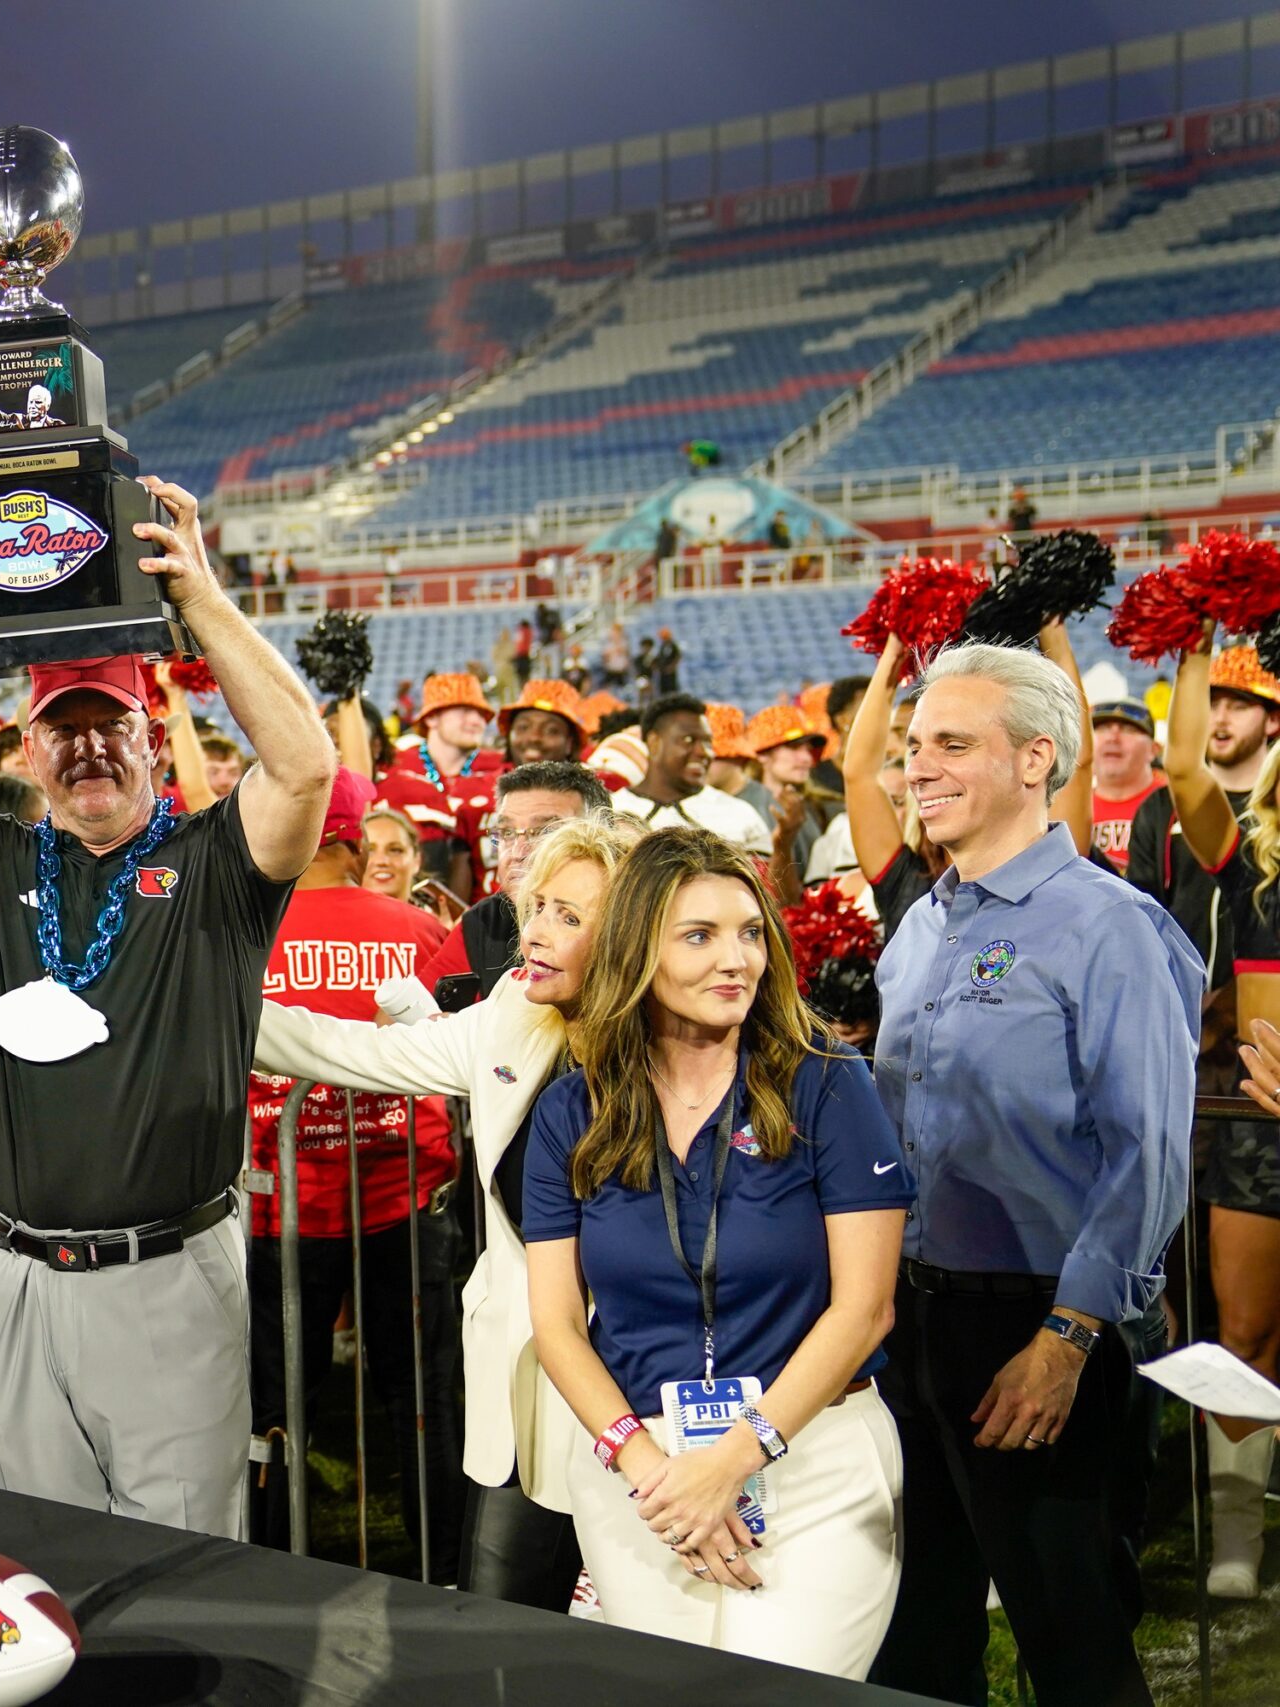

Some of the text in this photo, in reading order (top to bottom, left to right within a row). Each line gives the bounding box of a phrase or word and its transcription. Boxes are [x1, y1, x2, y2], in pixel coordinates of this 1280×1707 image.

[0, 381, 33, 391] TROPHY
[12, 461, 26, 469] BOCA
[26, 459, 43, 467] RATON
[3, 500, 43, 517] BUSH'S
[19, 524, 101, 556] Raton
[7, 560, 49, 572] BOWL
[8, 573, 50, 585] OF BEANS
[253, 1103, 283, 1119] Whe
[304, 1123, 343, 1135] mess
[695, 1403, 730, 1420] PBI
